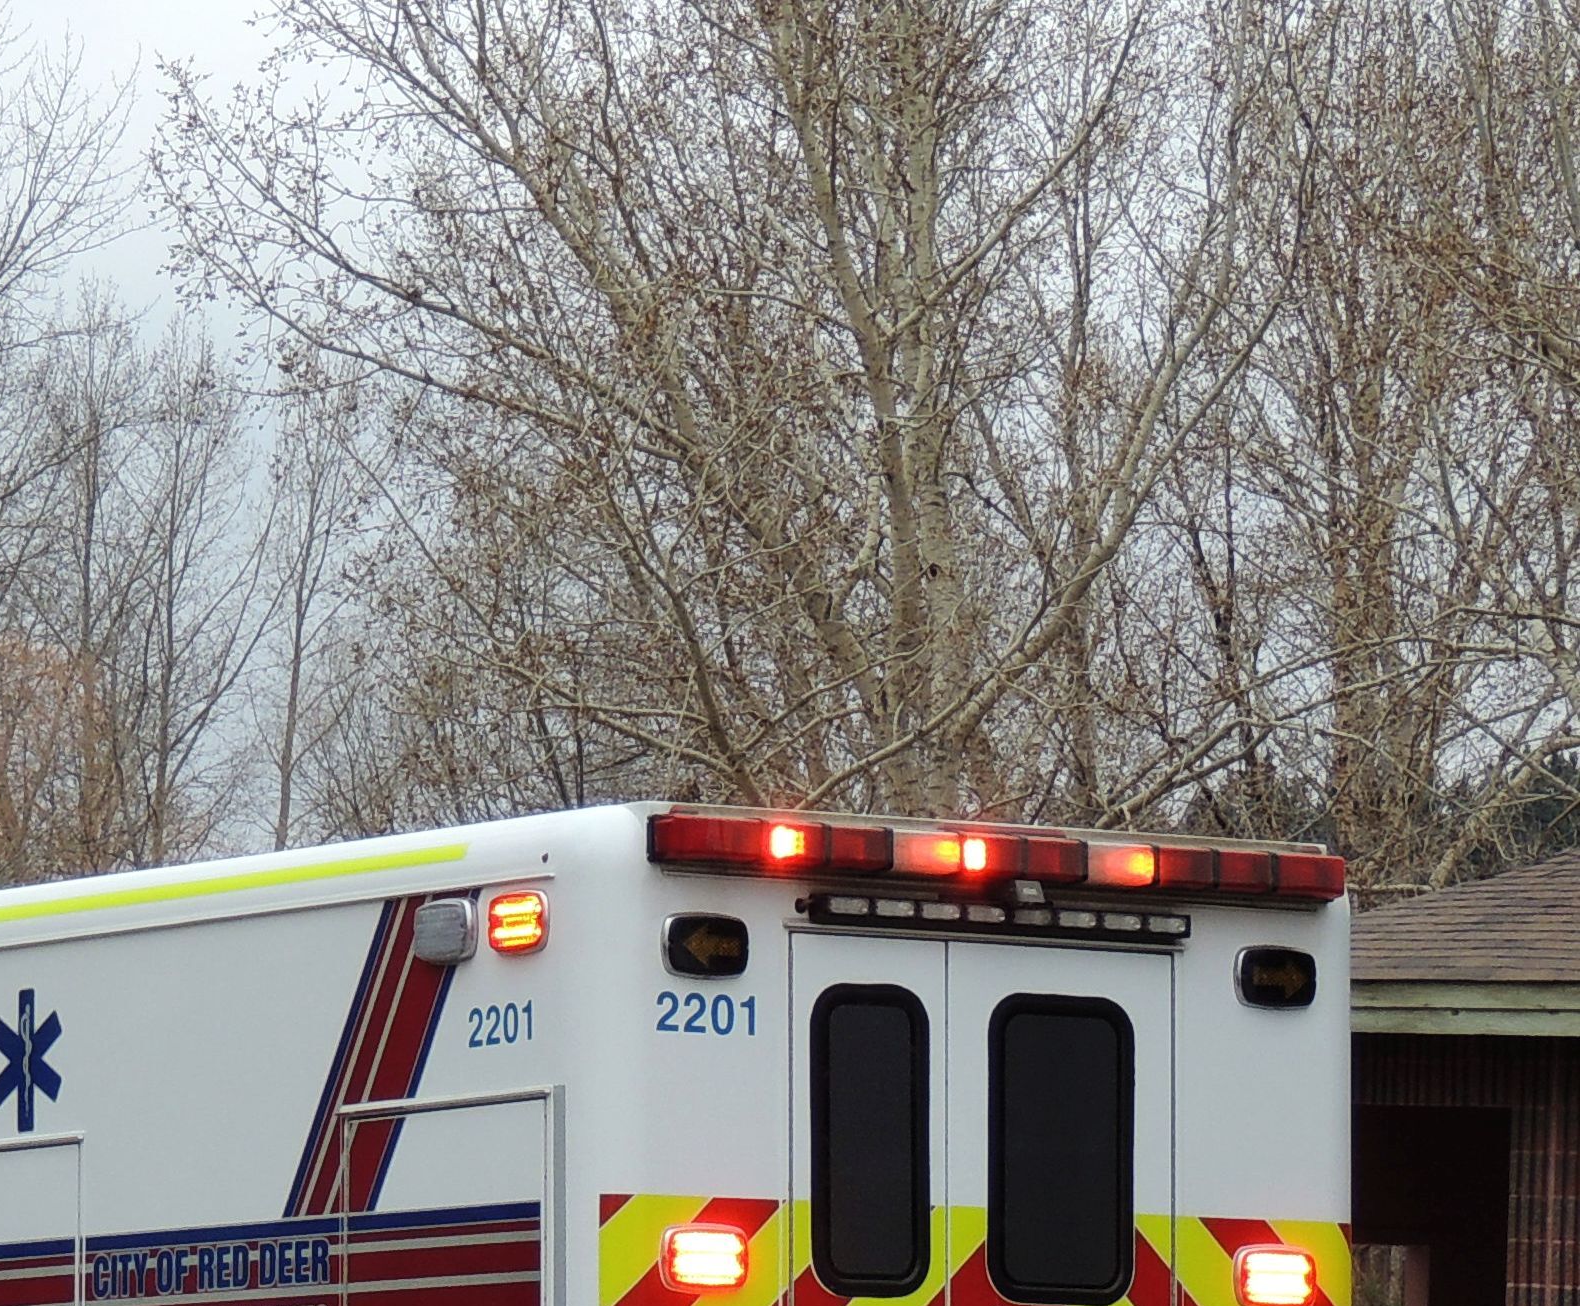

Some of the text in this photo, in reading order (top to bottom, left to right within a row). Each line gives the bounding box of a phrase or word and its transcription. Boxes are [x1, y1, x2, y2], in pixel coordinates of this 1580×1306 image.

[468, 999, 533, 1048] 2201
[656, 991, 756, 1036] 2201
[92, 1238, 330, 1299] CITY OF RED DEER
